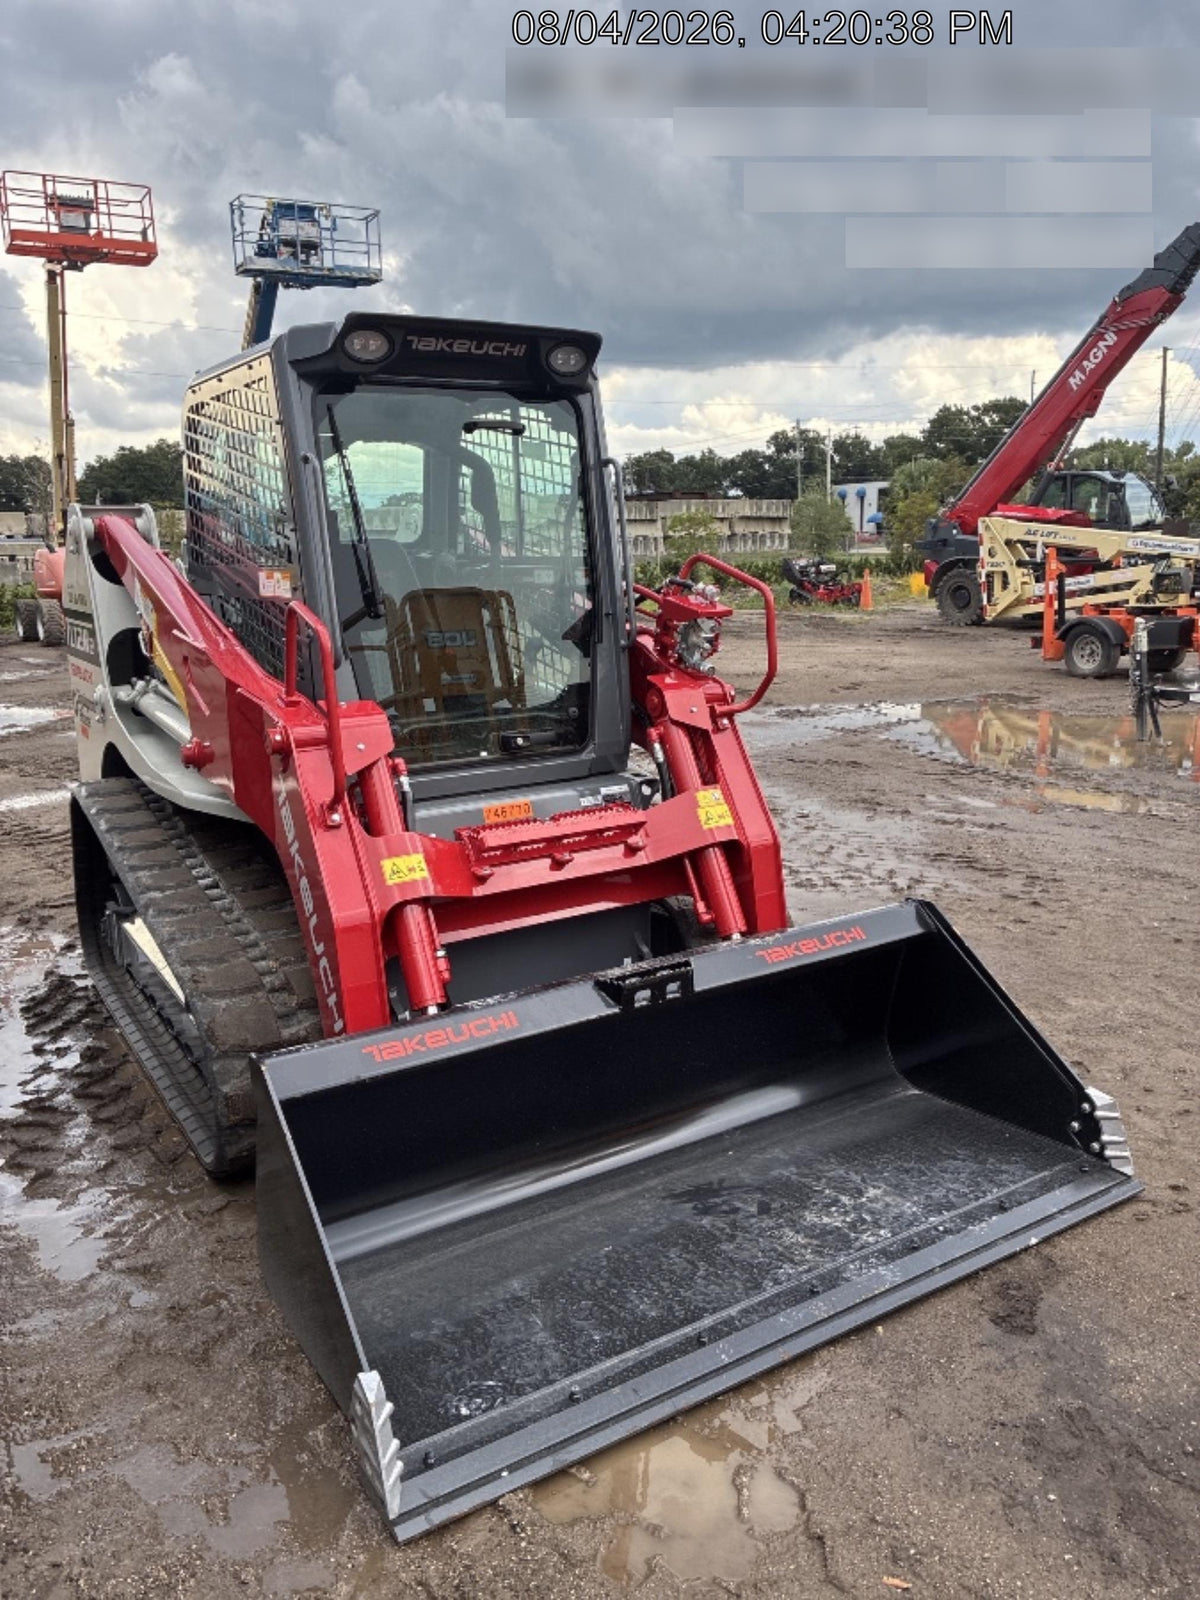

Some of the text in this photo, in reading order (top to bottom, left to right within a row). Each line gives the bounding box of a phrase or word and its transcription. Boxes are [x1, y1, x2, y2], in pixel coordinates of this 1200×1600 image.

[1068, 331, 1118, 391] MAGNI
[277, 773, 345, 1036] TAKEUCH
[755, 926, 867, 964] TAKEUCHI
[362, 1010, 520, 1062] TAKEUCHI
